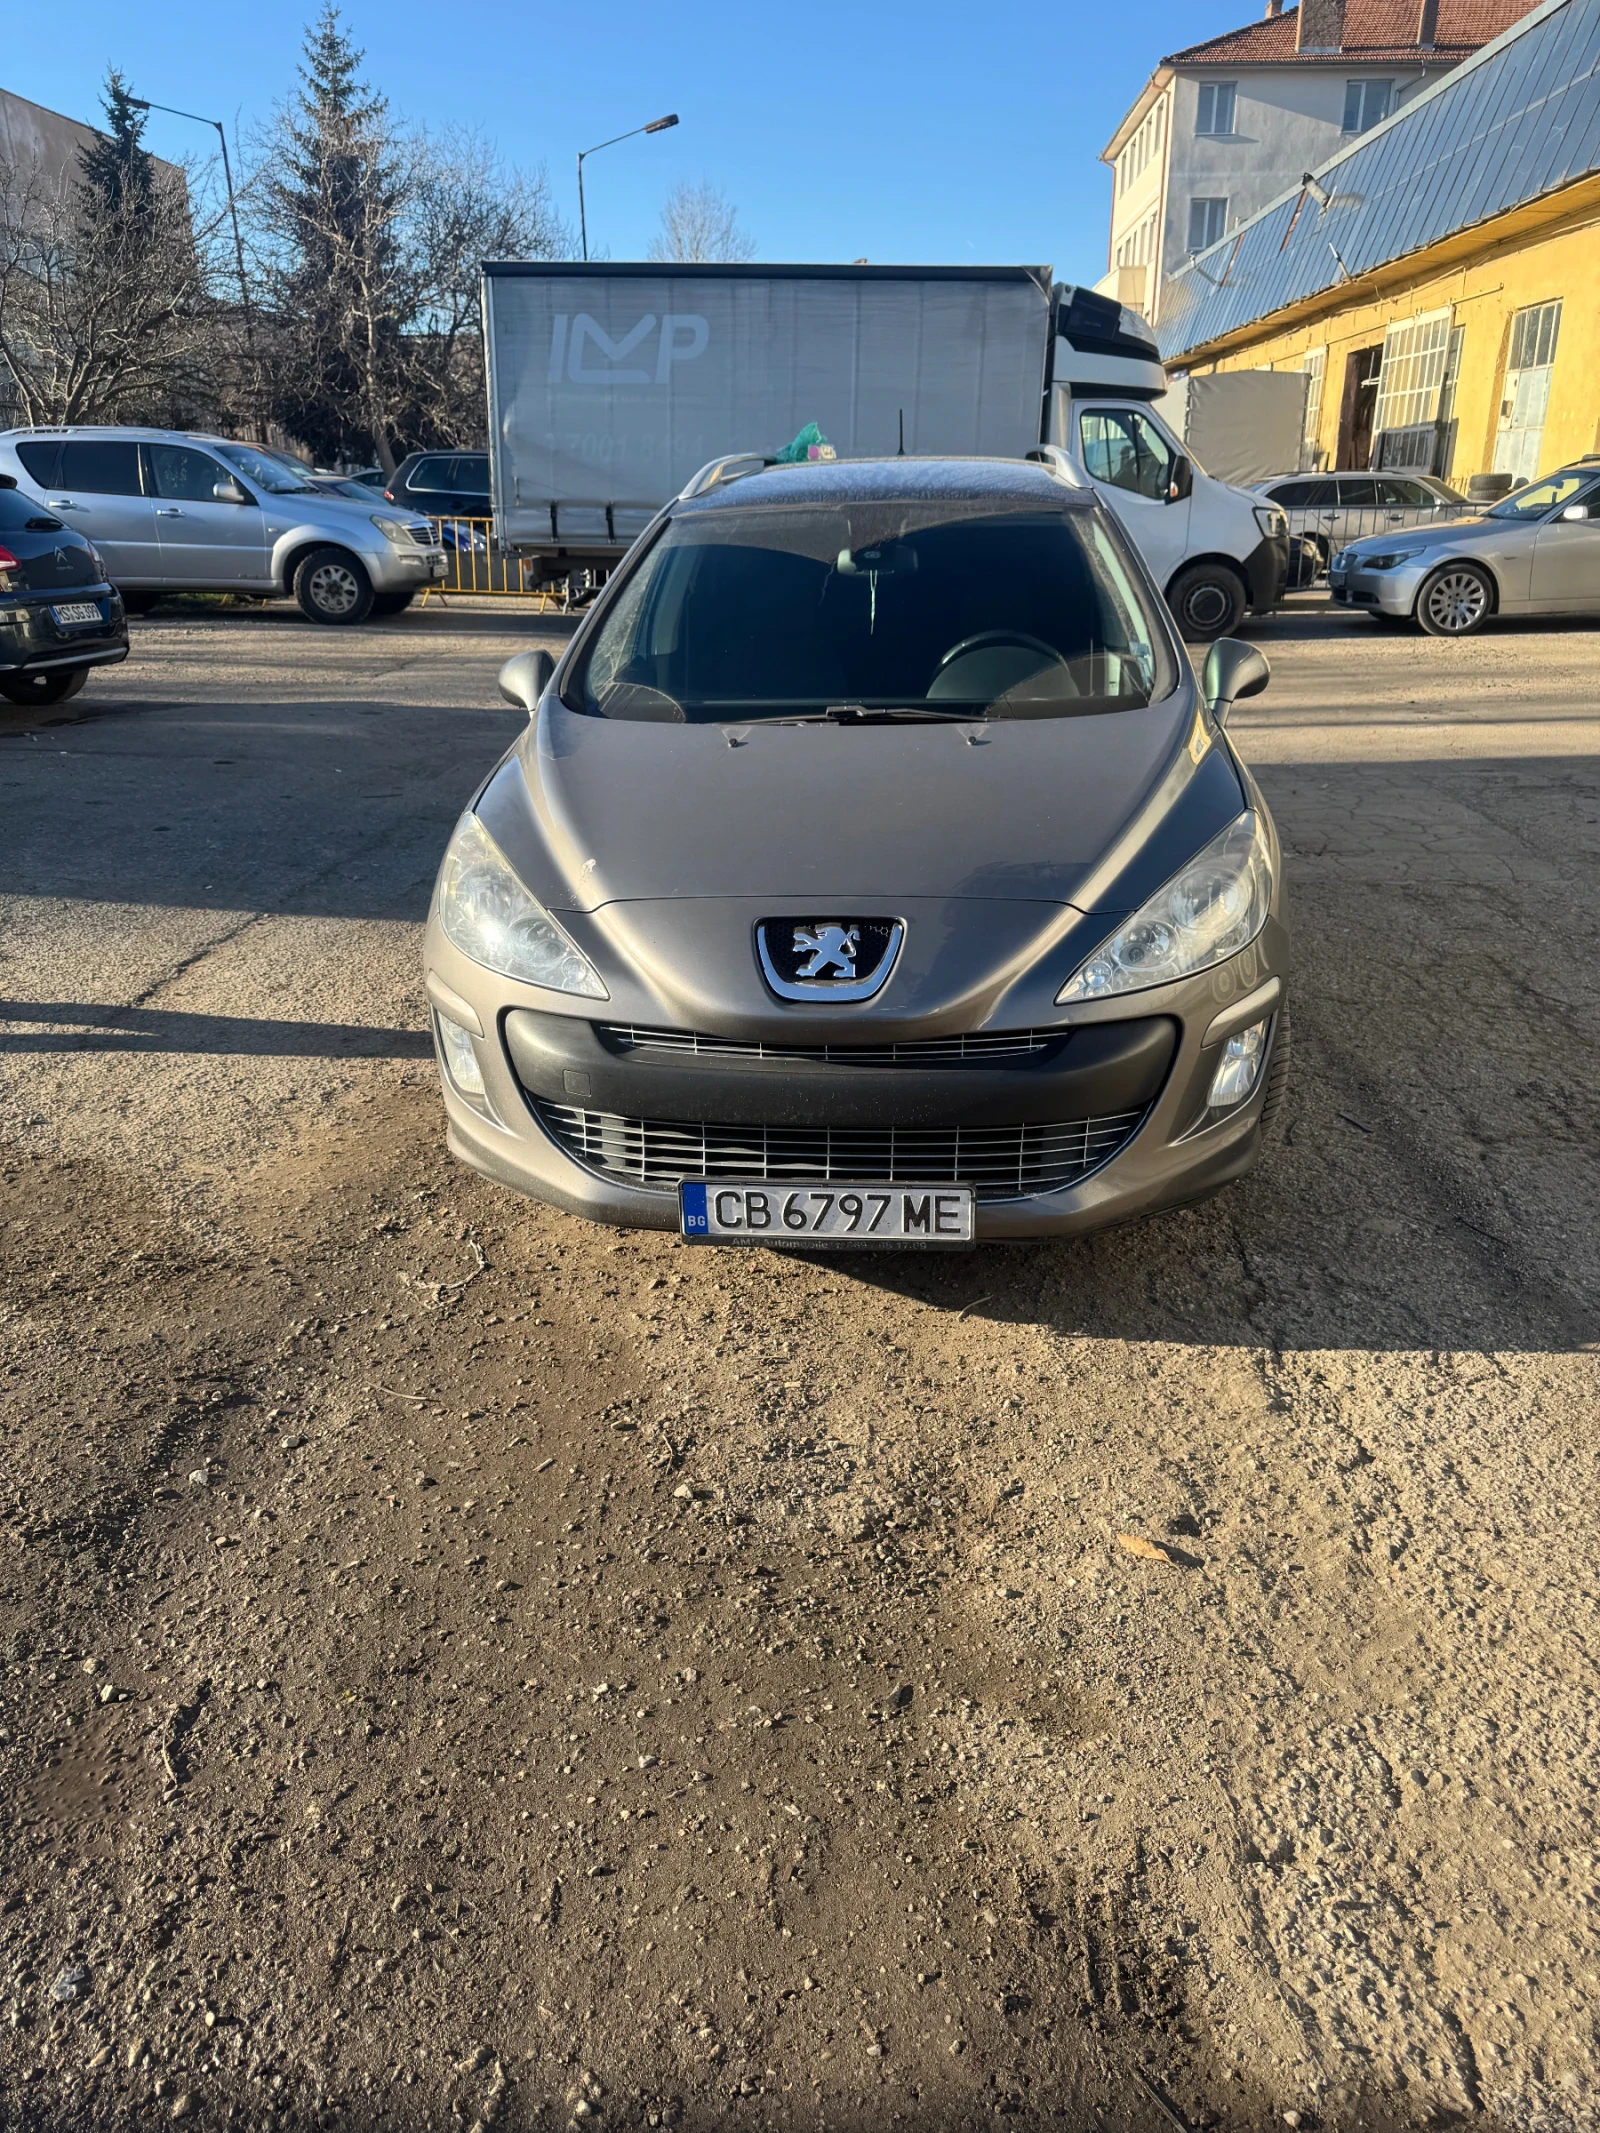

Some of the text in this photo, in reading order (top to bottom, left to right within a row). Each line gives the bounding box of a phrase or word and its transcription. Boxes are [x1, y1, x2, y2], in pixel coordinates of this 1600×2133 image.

[687, 1215, 706, 1227] BG
[714, 1190, 962, 1233] CB 6797 ME
